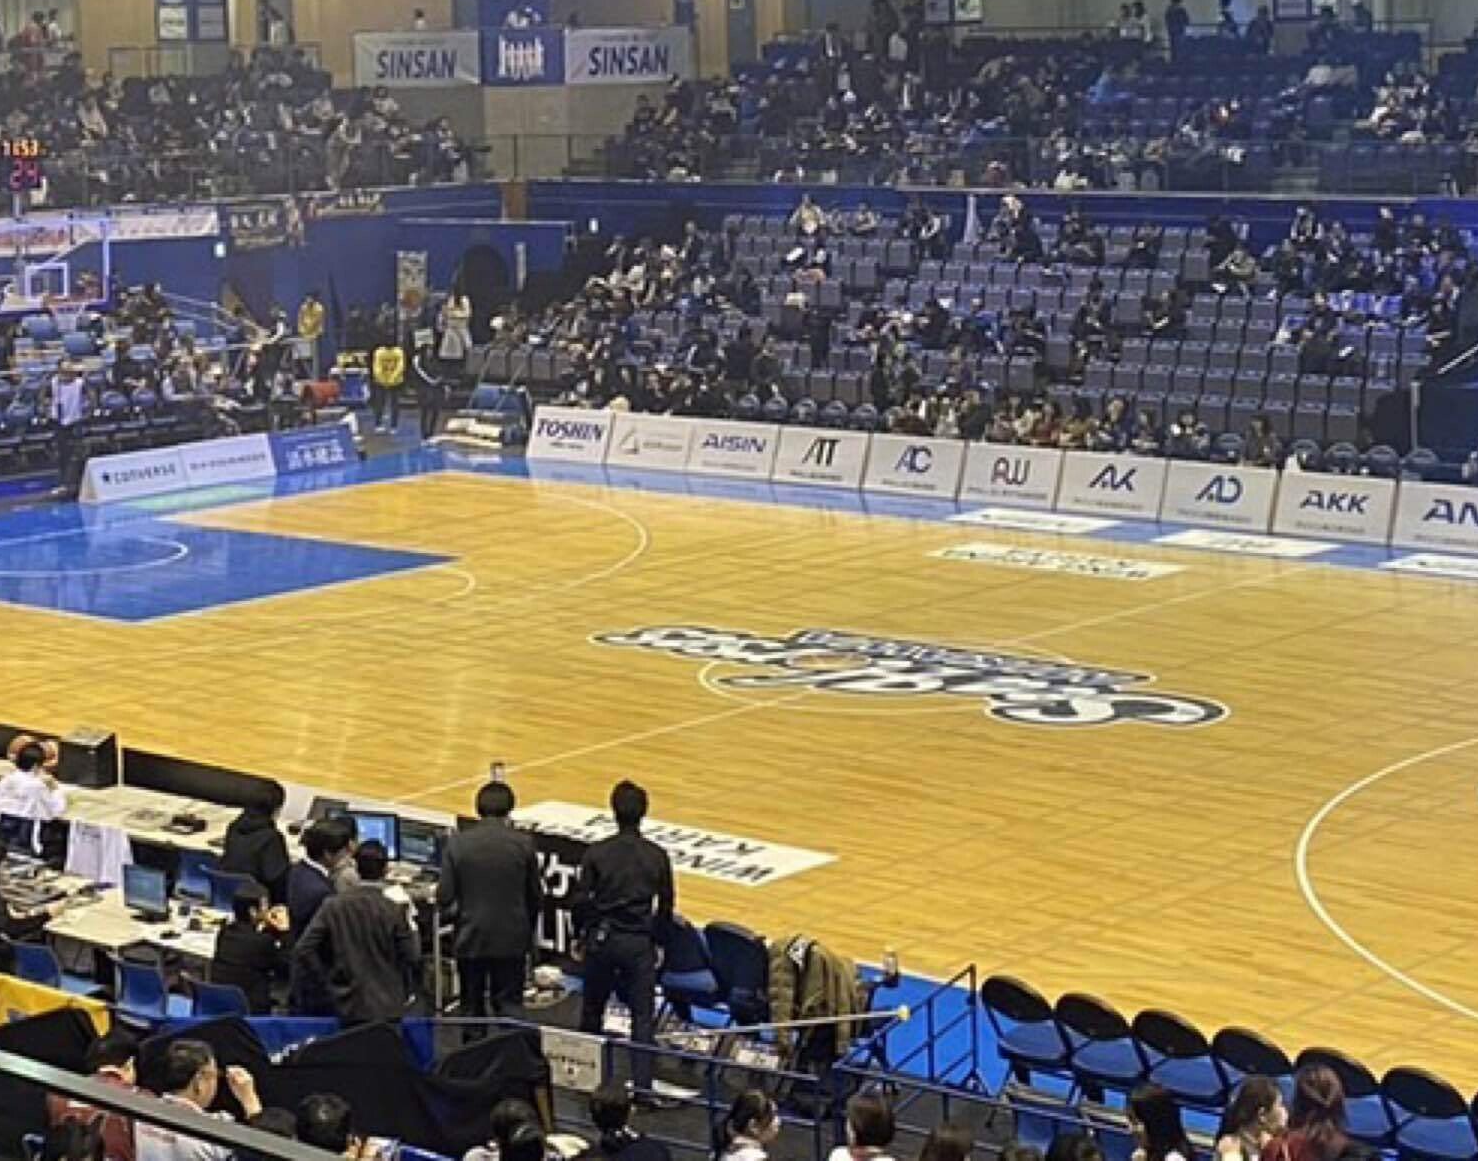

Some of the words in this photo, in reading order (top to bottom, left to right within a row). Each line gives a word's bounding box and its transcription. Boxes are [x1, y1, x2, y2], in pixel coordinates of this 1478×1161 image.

[376, 49, 458, 79] SINSAN
[587, 46, 671, 77] SINSAN
[536, 418, 605, 441] TOSHIN
[702, 432, 766, 454] AISIN
[1299, 489, 1370, 515] AKK
